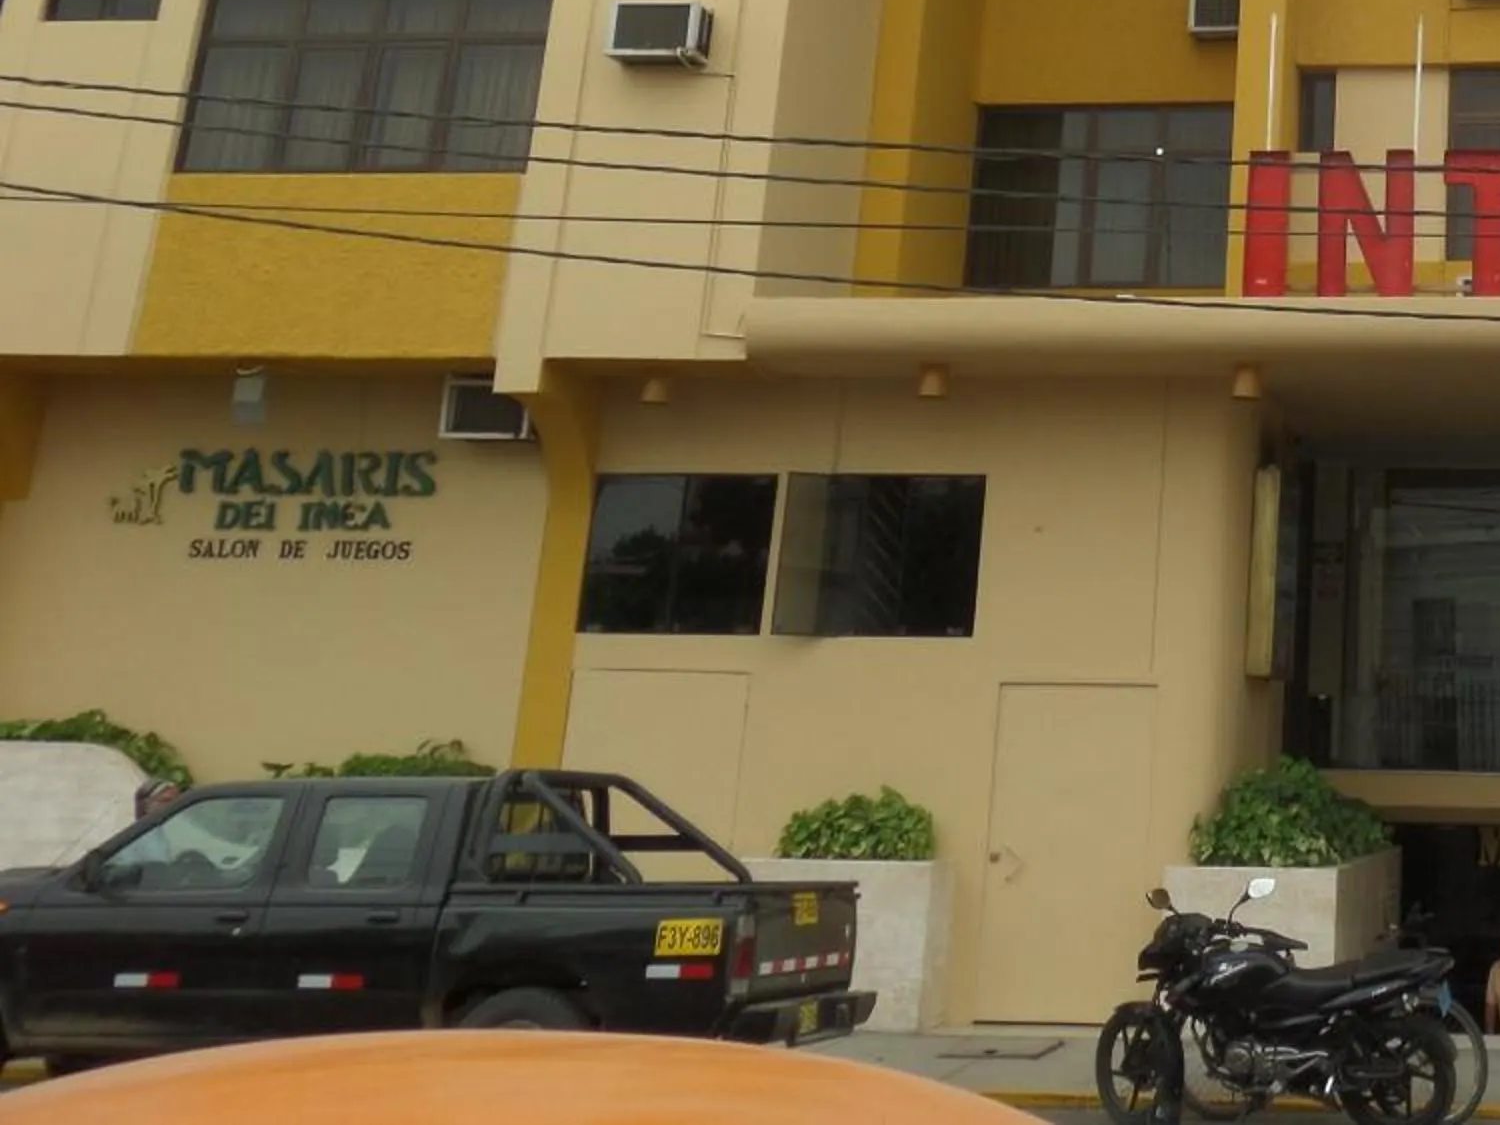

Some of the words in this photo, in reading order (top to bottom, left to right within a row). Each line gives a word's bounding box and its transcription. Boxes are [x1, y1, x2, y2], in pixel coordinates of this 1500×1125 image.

[178, 448, 438, 497] MASARIS
[189, 539, 260, 559] SALON
[279, 539, 307, 560] DE
[326, 540, 413, 561] JUEGOS
[657, 925, 720, 951] F3Y-896
